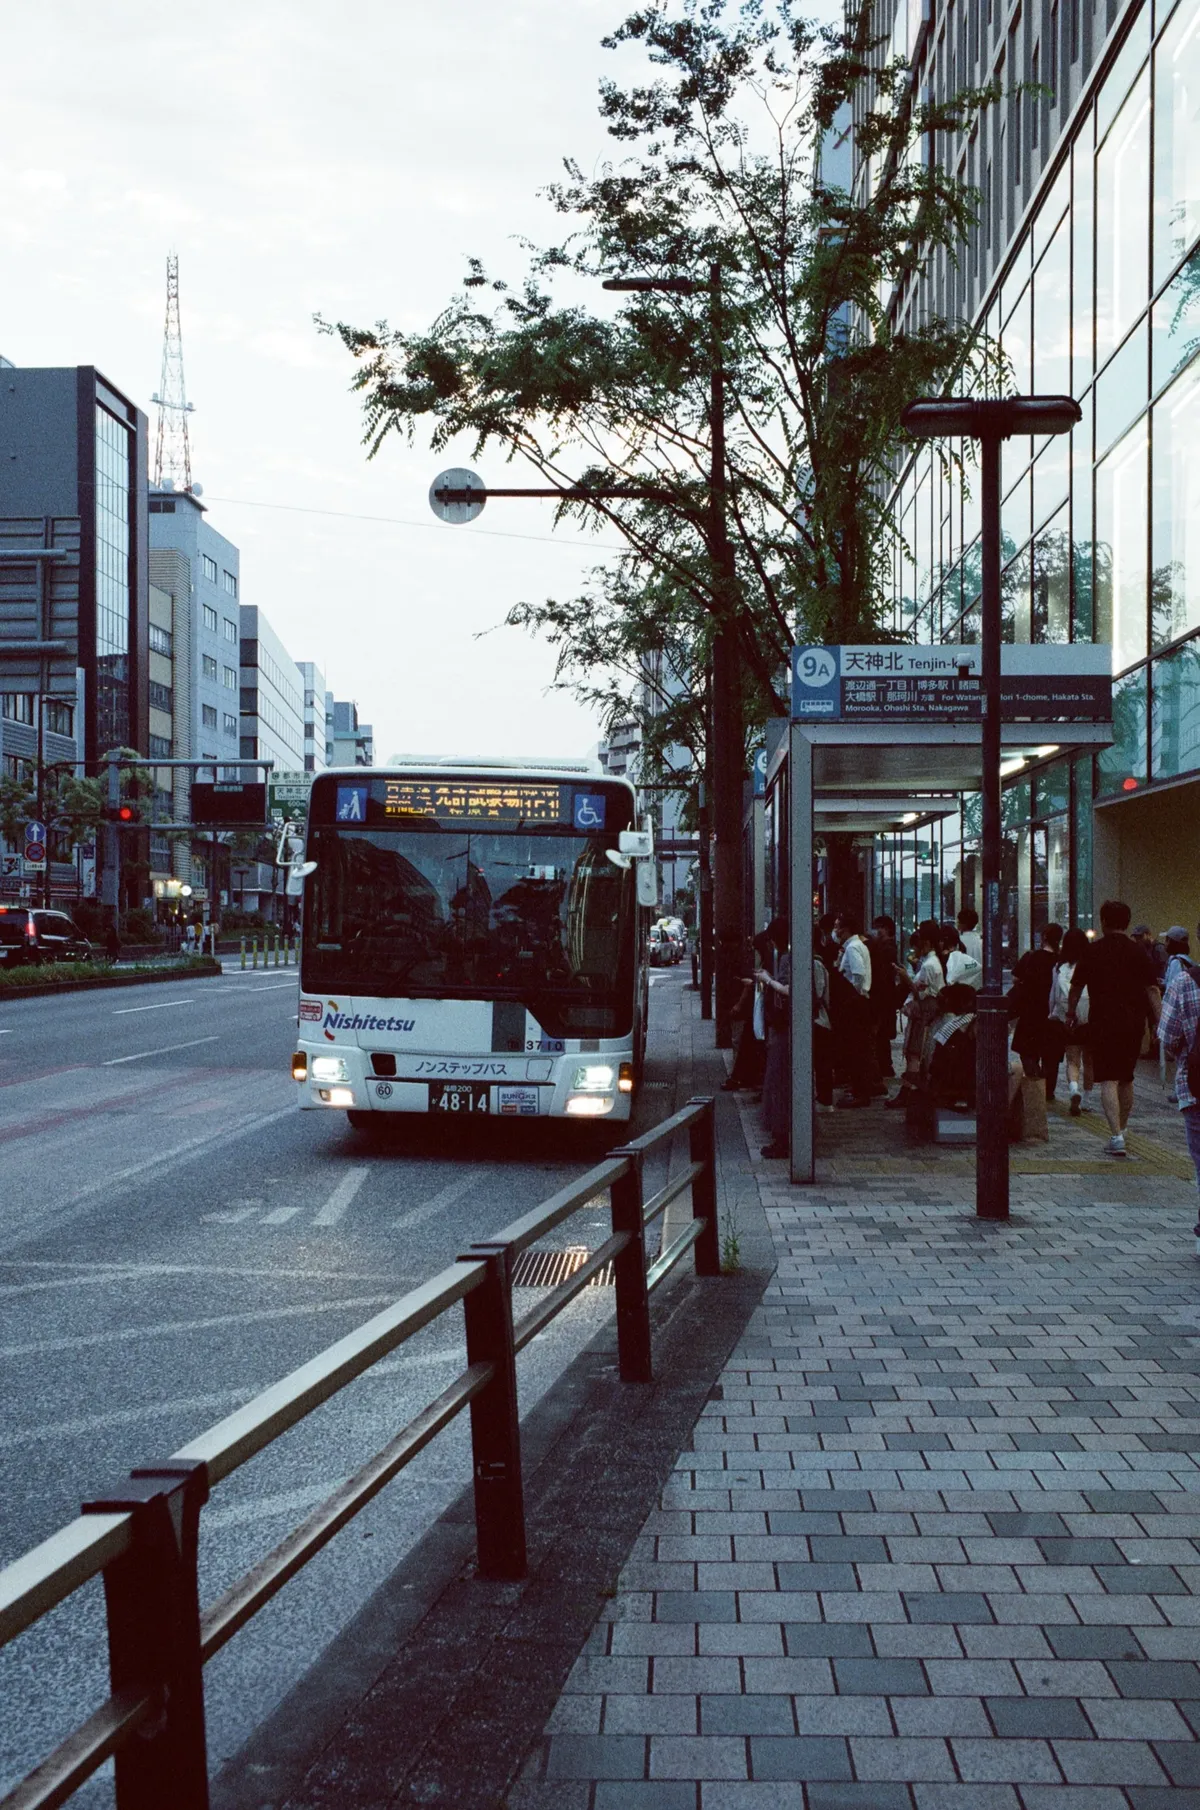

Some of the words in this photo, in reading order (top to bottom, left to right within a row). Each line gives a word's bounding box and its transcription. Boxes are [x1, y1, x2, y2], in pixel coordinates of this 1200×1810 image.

[802, 656, 830, 678] 9A
[845, 651, 904, 671] 天神北
[908, 657, 976, 672] Tenjin-ka
[917, 680, 949, 691] 博多駅
[845, 691, 877, 703] 大橋駅
[1052, 693, 1080, 701] Hakata
[883, 703, 911, 712] Ohashi
[928, 703, 969, 714] Nakagawa
[283, 772, 317, 780] 都市高
[322, 1012, 416, 1032] Nishitetsu
[525, 1040, 563, 1051] 3710
[415, 1061, 508, 1075] ノンステップバス
[378, 1085, 391, 1096] 60
[439, 1092, 487, 1112] 48-14
